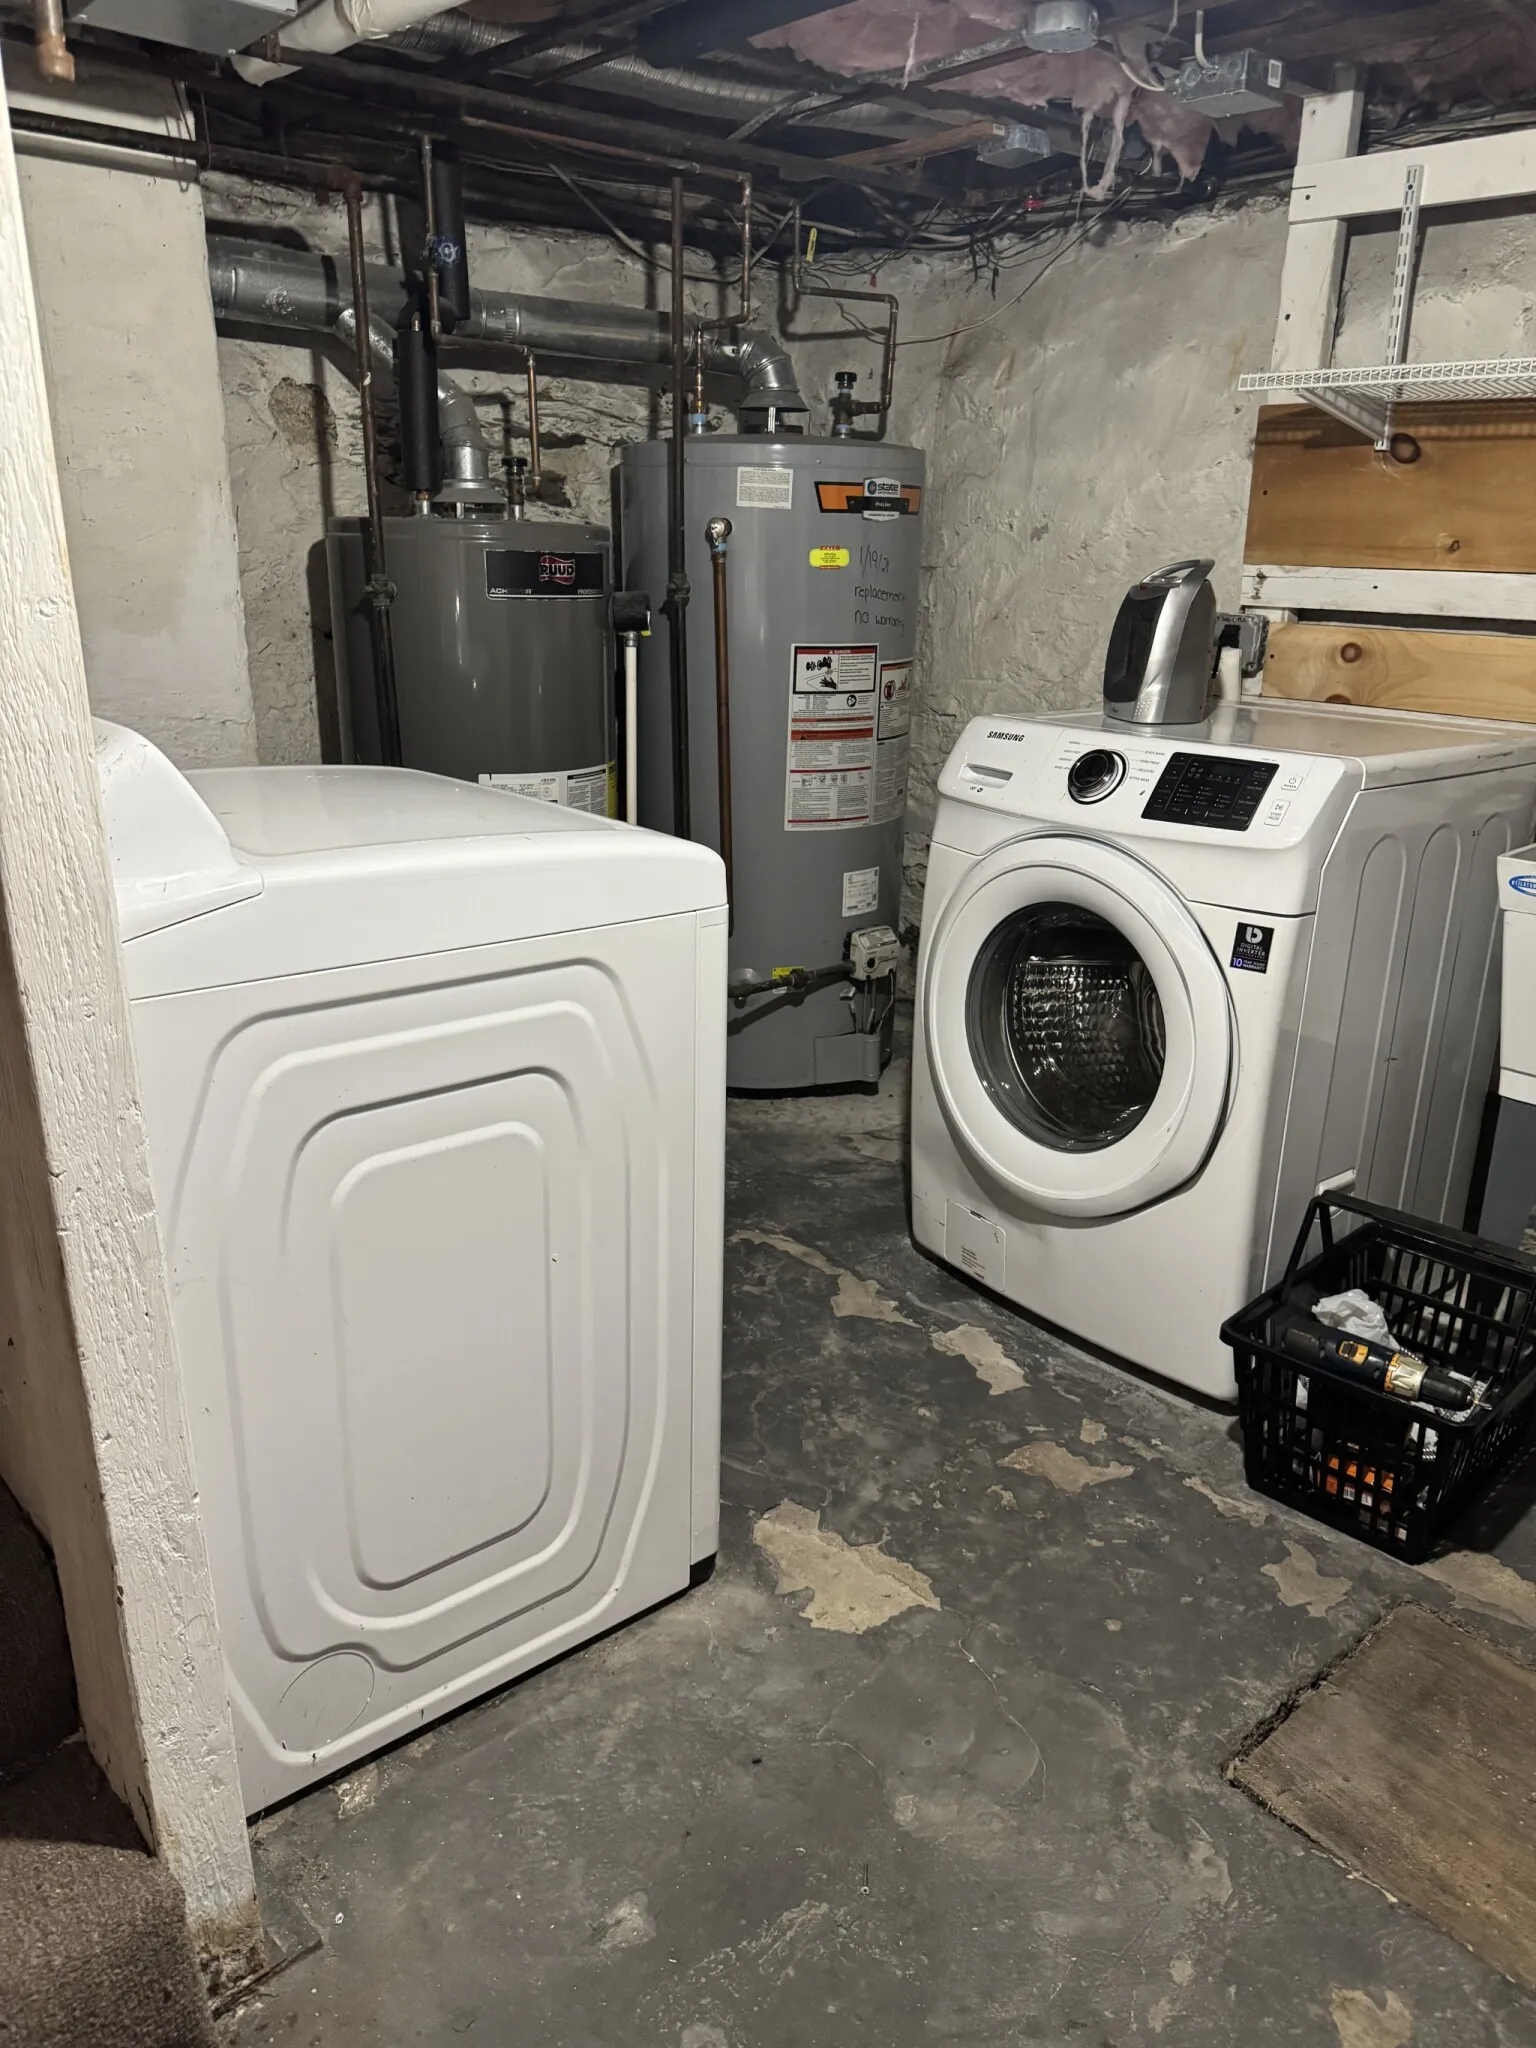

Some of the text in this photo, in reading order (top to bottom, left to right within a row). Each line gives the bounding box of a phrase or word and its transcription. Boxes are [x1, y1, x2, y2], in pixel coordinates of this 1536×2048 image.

[877, 483, 899, 492] state
[541, 564, 574, 576] RUUD
[854, 610, 870, 624] no
[987, 731, 1025, 742] SAMSUNG
[1236, 947, 1266, 956] INVERTER
[1240, 943, 1263, 951] DIGITAL
[1233, 958, 1243, 967] 10
